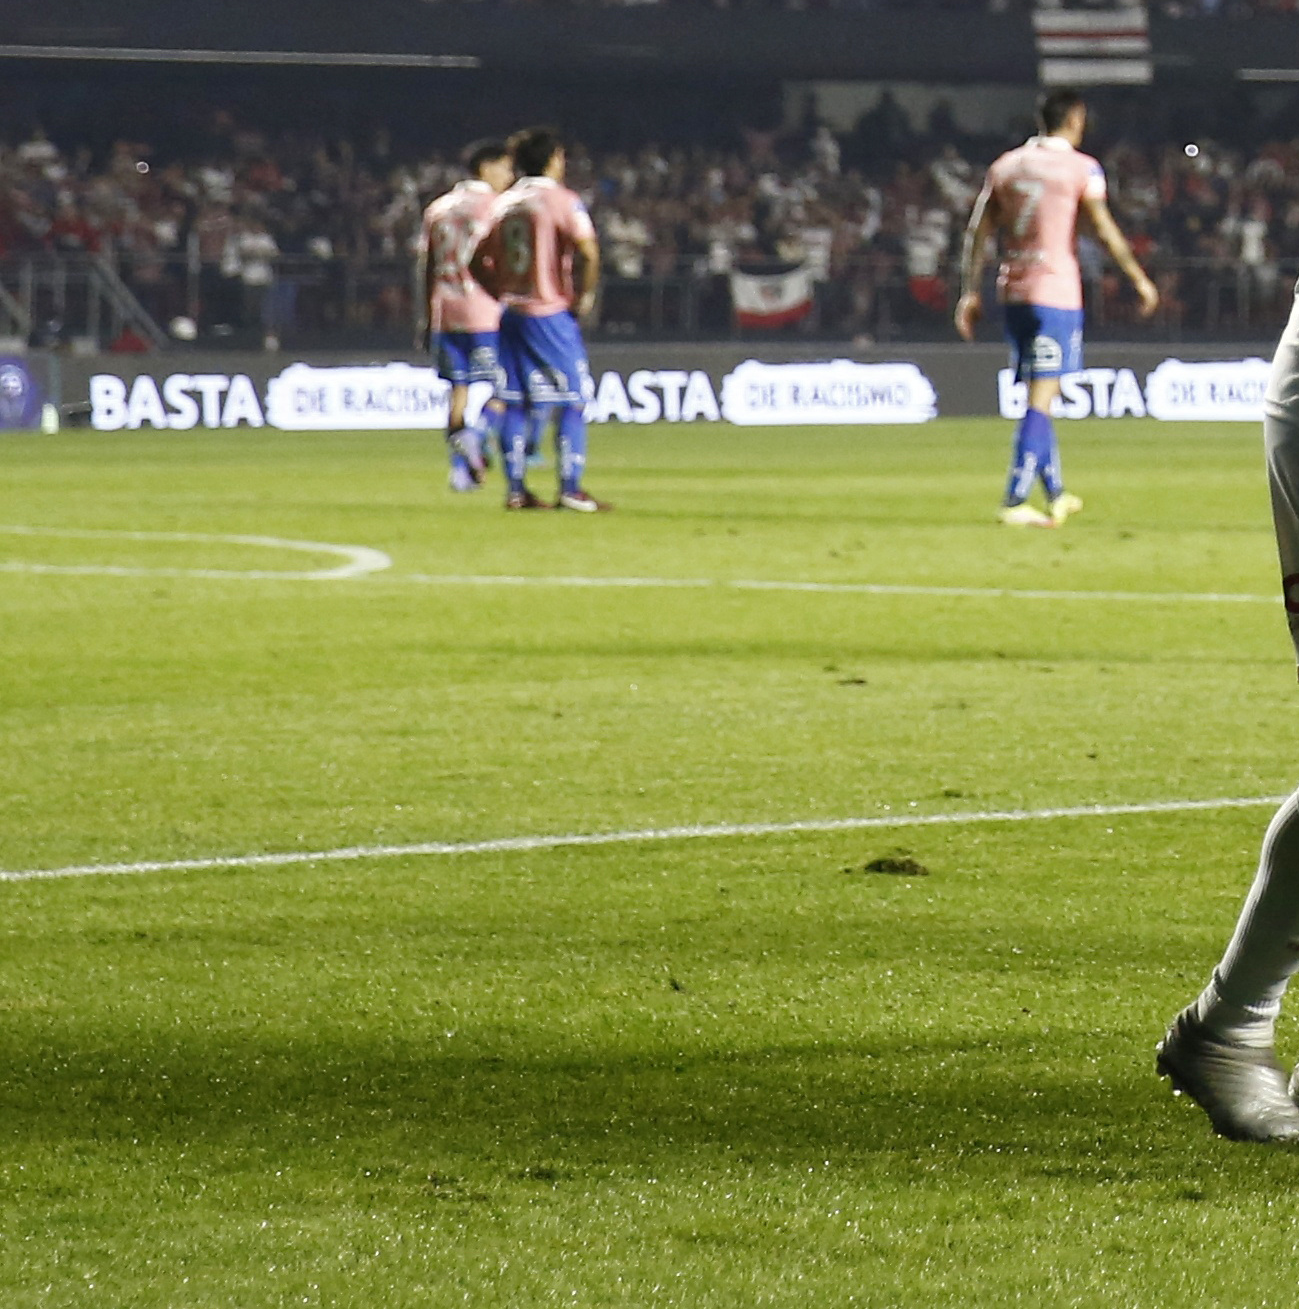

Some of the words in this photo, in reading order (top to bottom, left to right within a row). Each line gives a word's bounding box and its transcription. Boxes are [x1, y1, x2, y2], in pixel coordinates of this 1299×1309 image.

[1012, 179, 1044, 237] 7
[90, 374, 265, 430] BASTA
[296, 386, 327, 414] DE
[341, 384, 449, 414] RACISM
[745, 381, 777, 409] DE
[789, 380, 911, 409] RACISMO
[998, 368, 1147, 419] BSTA
